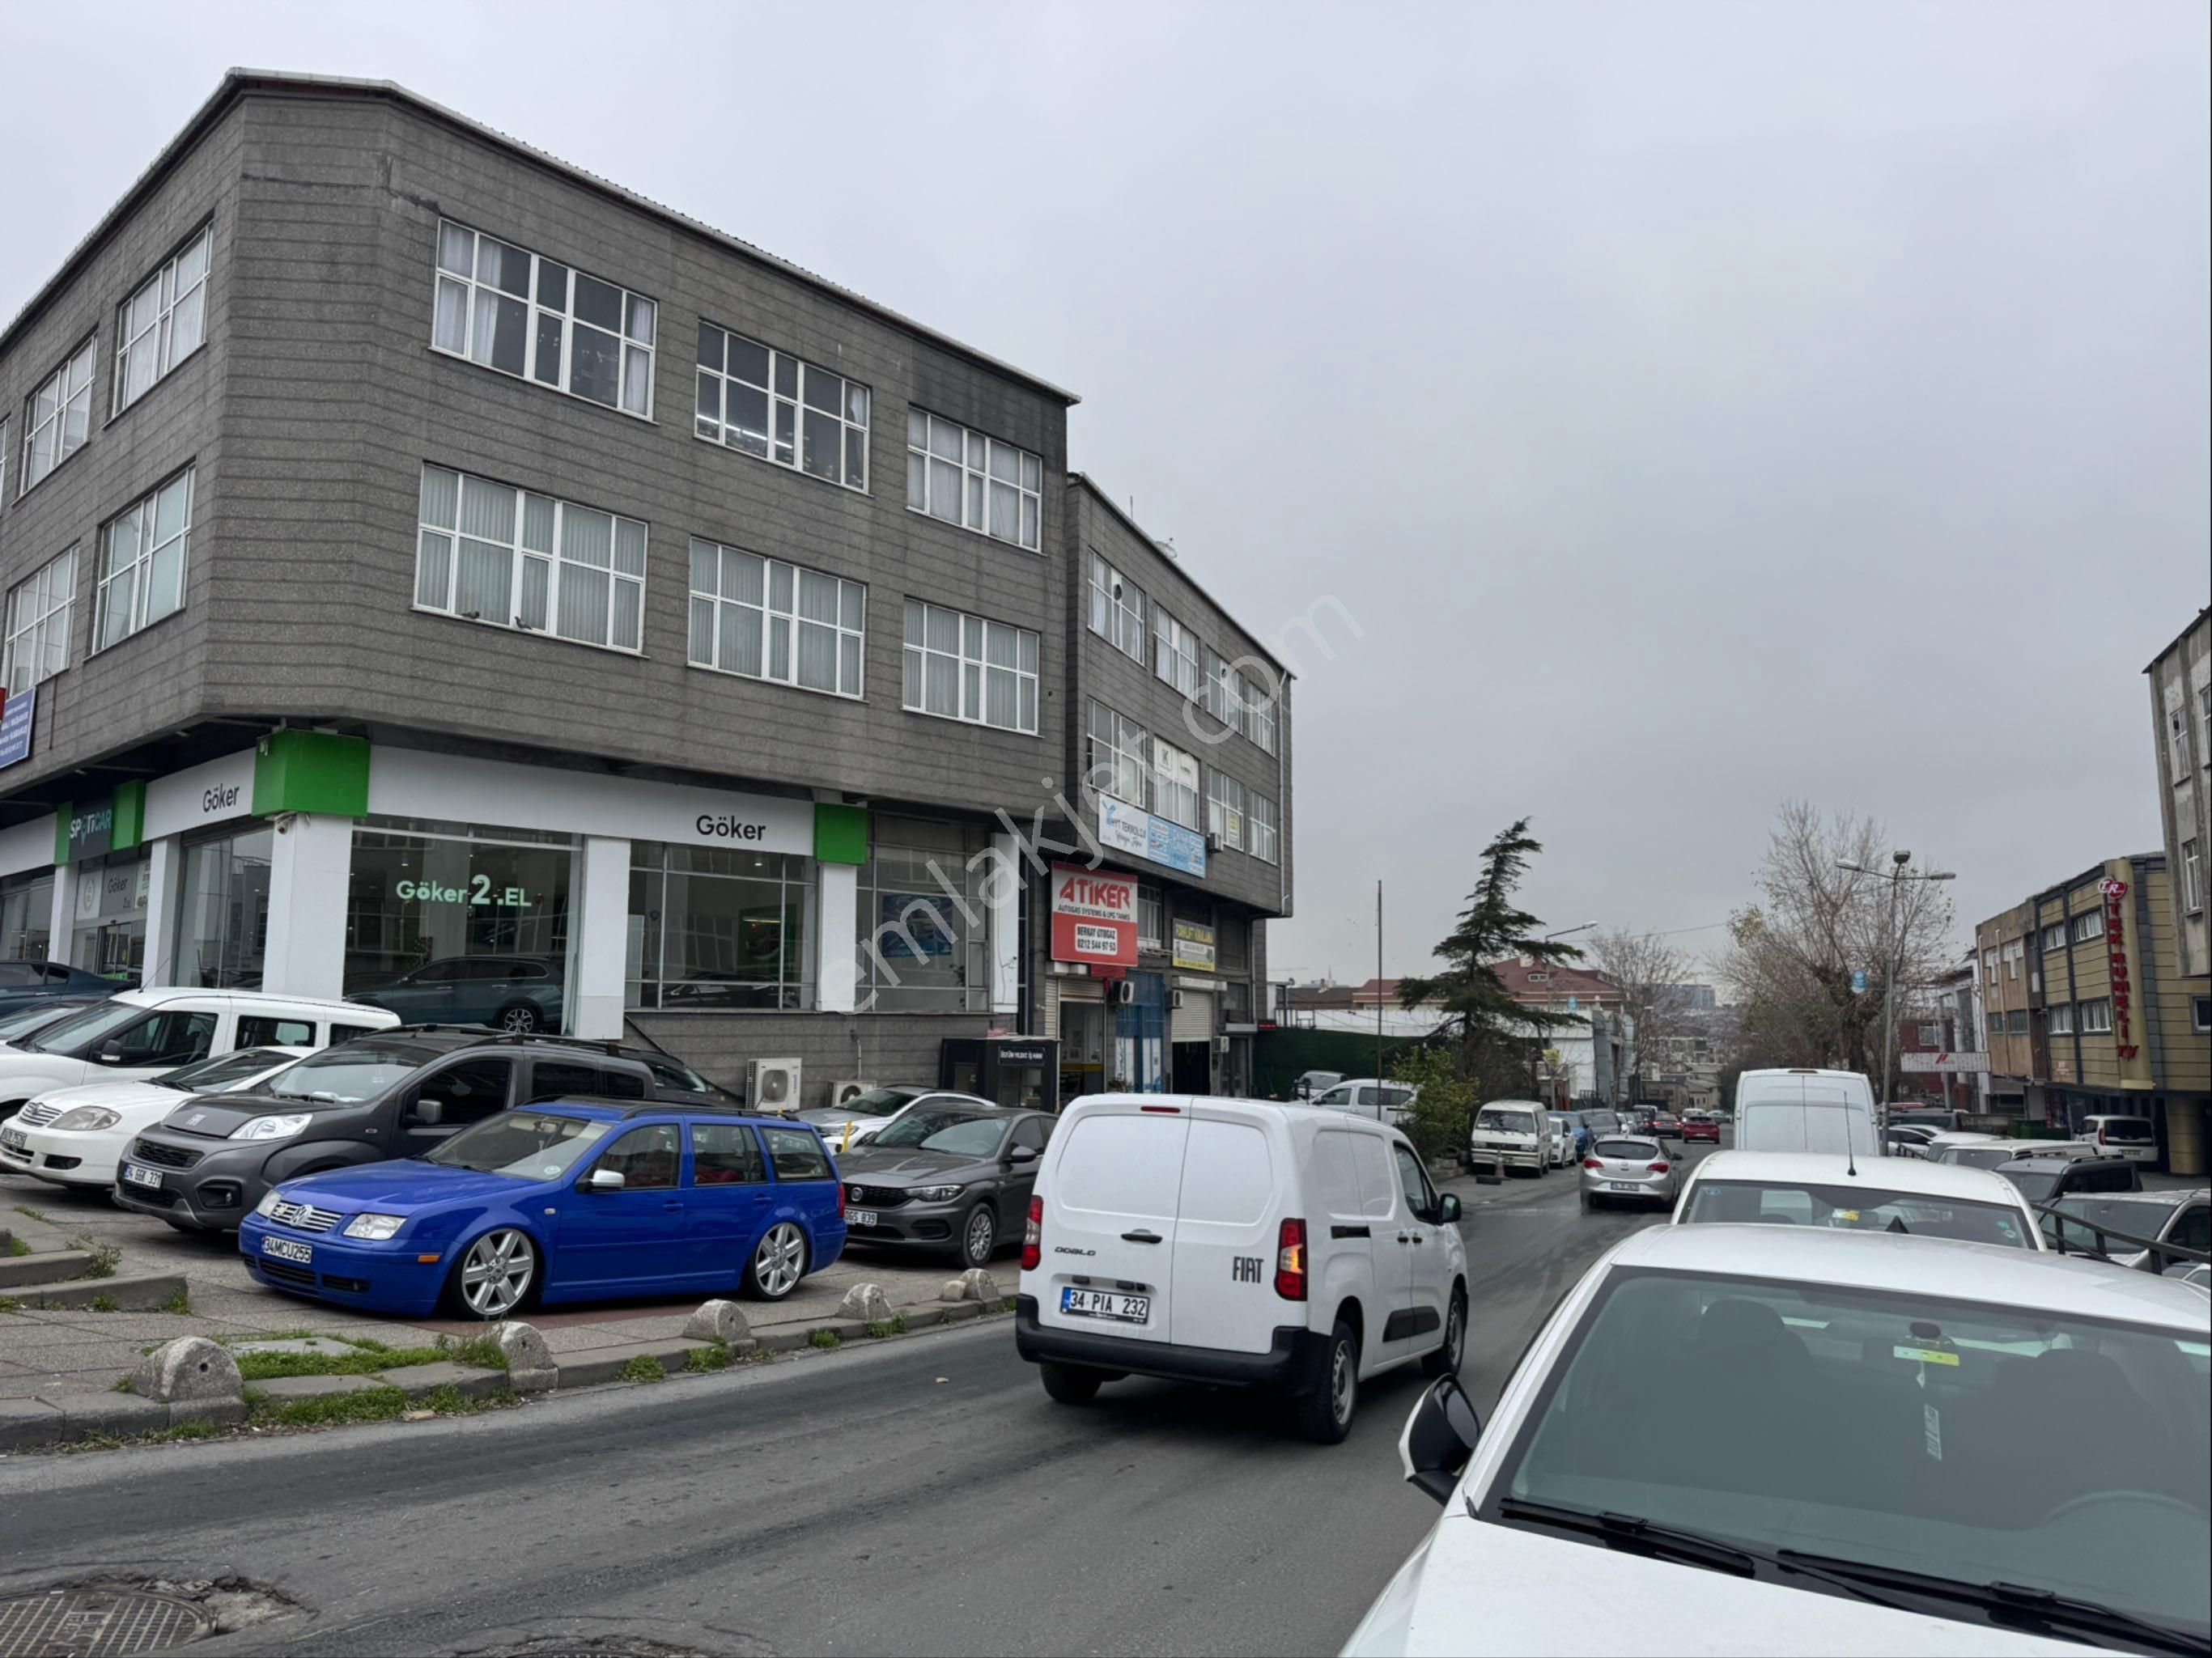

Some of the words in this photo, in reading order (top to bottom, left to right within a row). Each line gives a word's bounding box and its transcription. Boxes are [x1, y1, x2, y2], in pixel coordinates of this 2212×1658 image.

[203, 782, 240, 812] Göker
[696, 815, 766, 841] Göker
[397, 880, 468, 903] Göker
[1058, 905, 1081, 914] AUTOGAS
[1082, 908, 1102, 917] SYSTEMS
[1077, 939, 1090, 949] 0212
[1055, 1246, 1096, 1256] DOBLO
[1233, 1256, 1263, 1283] FIAT
[1070, 1291, 1085, 1308] 34
[1092, 1294, 1112, 1312] PIA
[1123, 1298, 1145, 1317] 232
